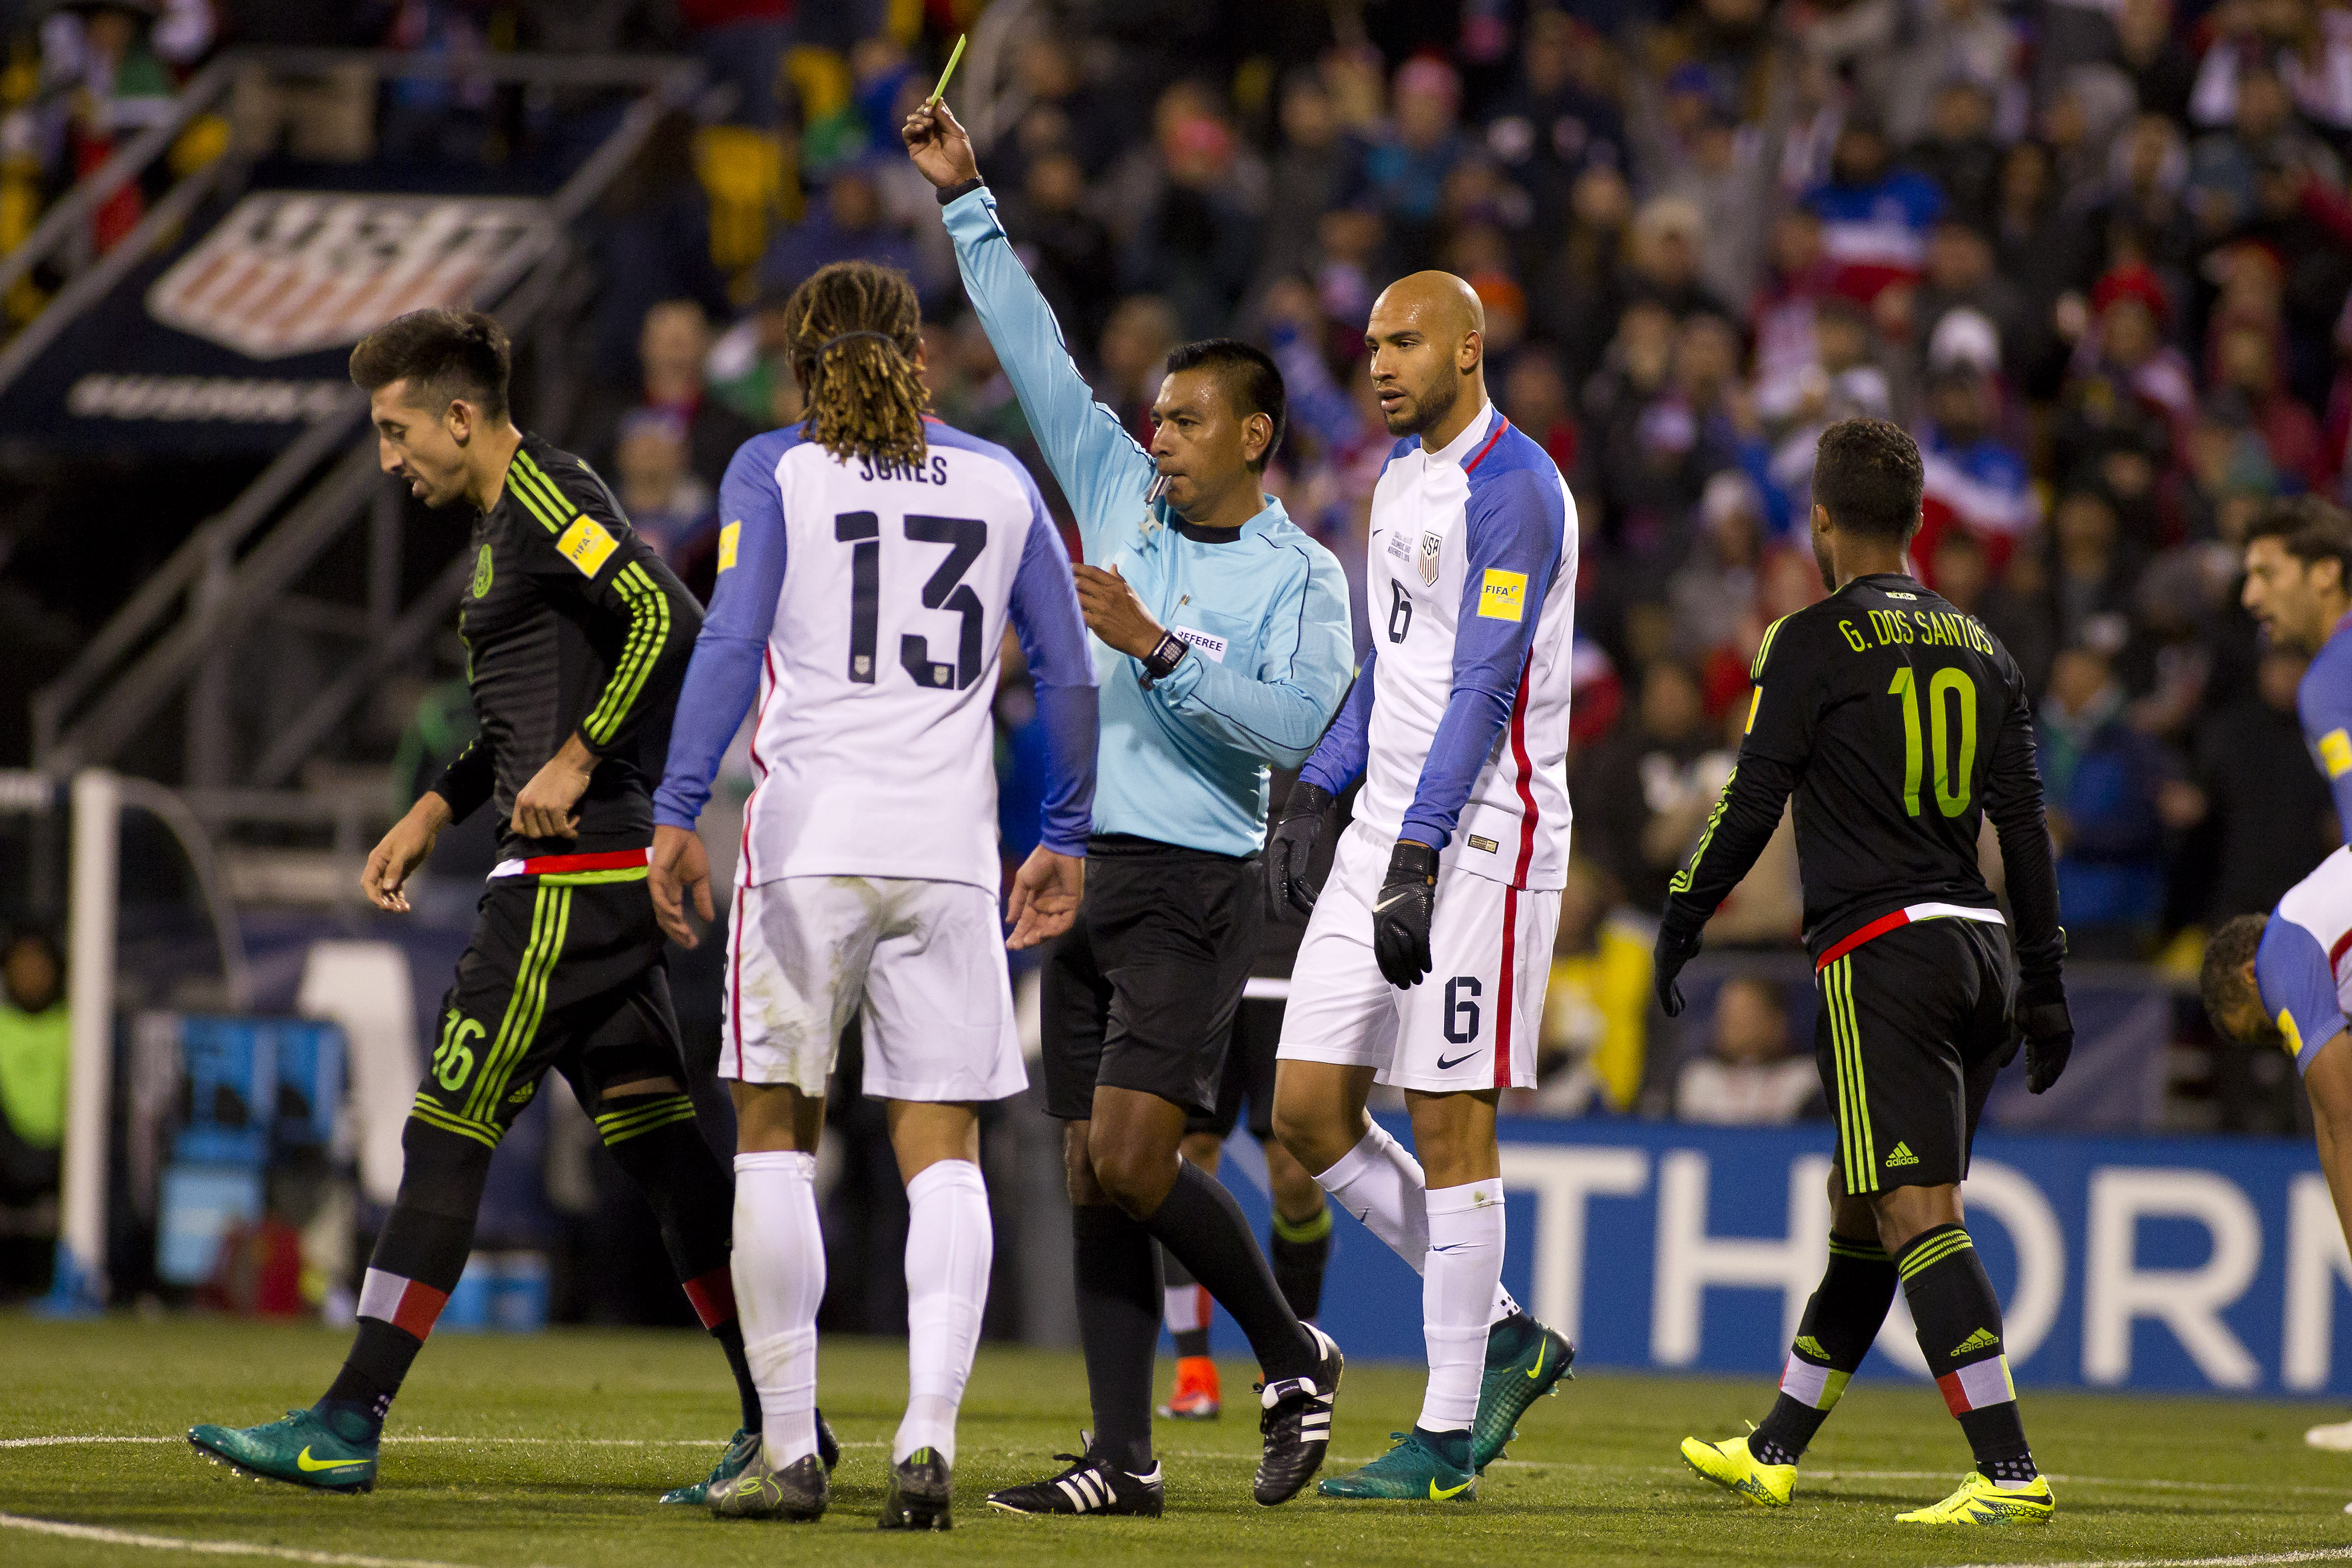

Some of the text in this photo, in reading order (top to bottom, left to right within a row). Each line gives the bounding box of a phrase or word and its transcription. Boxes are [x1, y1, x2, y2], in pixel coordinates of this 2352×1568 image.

[570, 537, 590, 560] FIFA
[1422, 534, 1440, 557] USA
[834, 510, 988, 691] 13
[1388, 577, 1413, 644] 6
[1485, 585, 1509, 596] FIFA
[1838, 609, 1993, 656] G. DOS SANTOS
[1887, 667, 1976, 818] 10
[1443, 976, 1482, 1044] 6
[431, 1007, 486, 1091] 16
[1885, 1155, 1920, 1168] adidas
[1950, 1336, 1999, 1356] adidas
